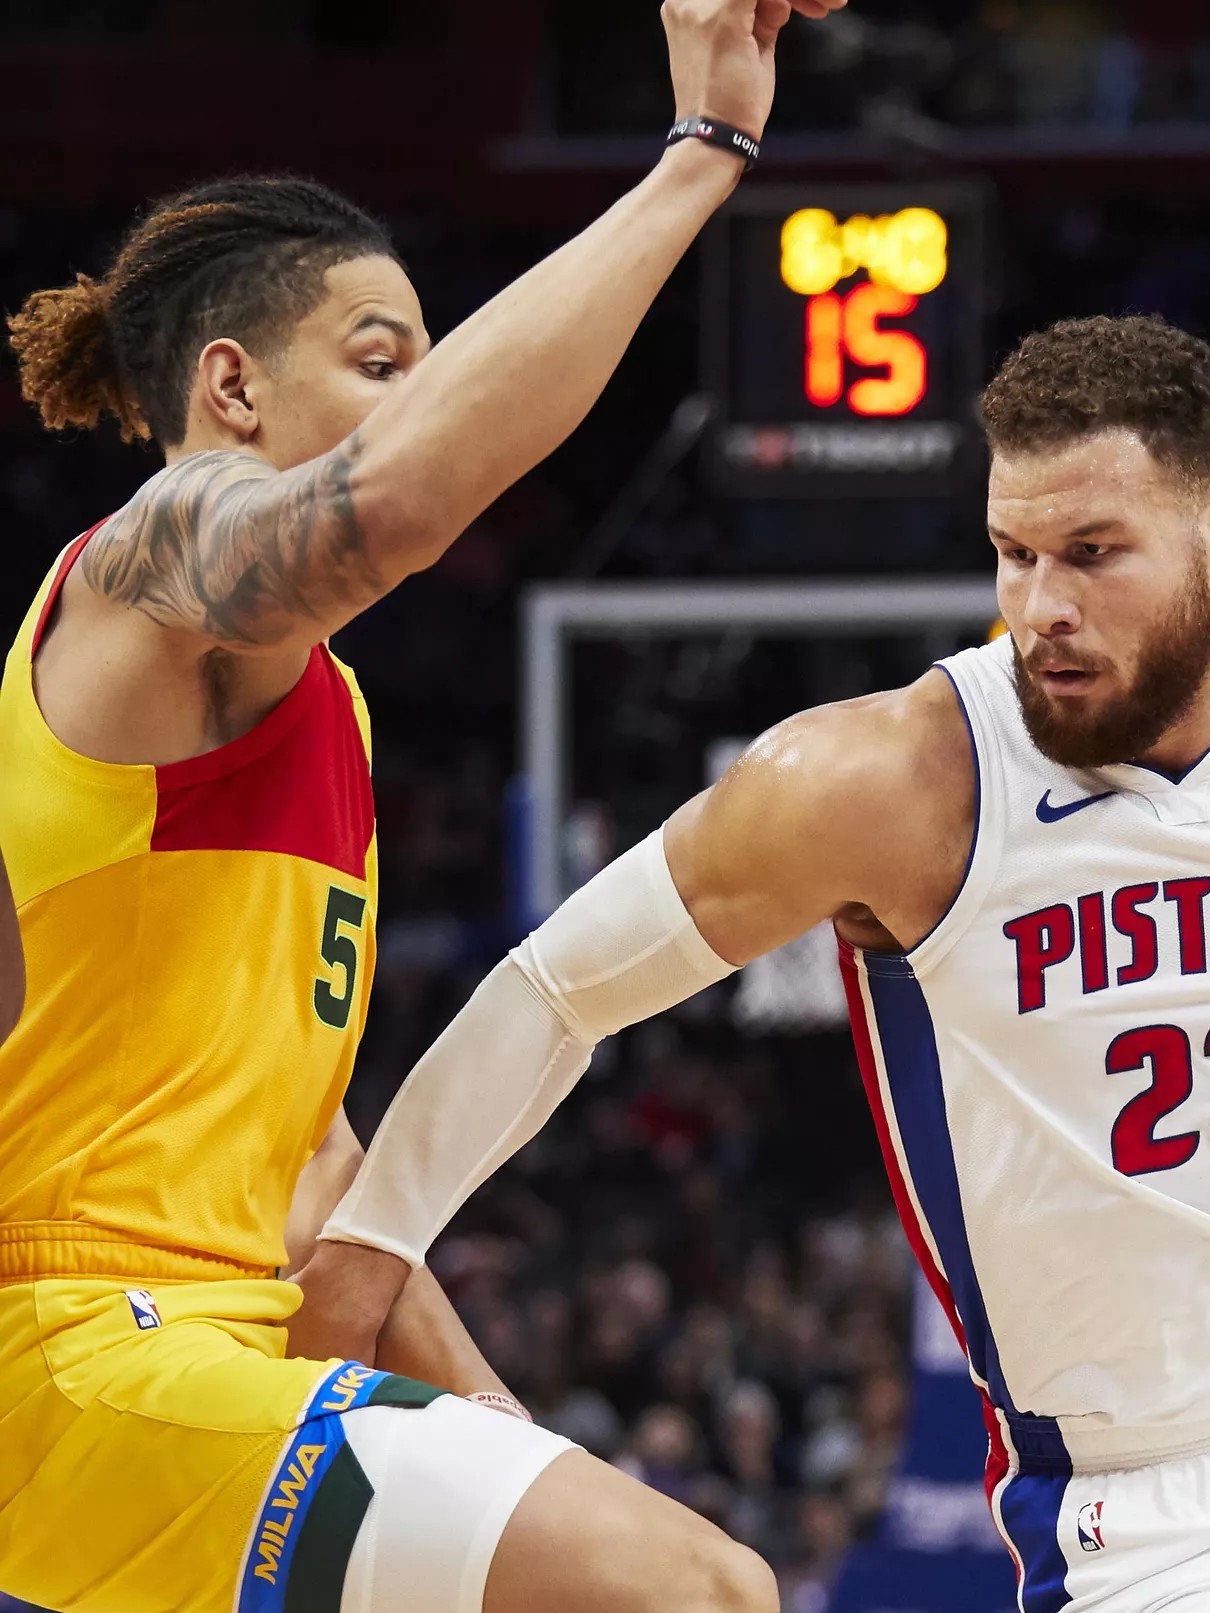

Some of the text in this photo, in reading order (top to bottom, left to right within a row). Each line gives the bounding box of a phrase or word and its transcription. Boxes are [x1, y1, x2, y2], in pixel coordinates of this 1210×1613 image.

[805, 281, 927, 417] 15
[312, 883, 368, 1032] 5
[138, 1315, 155, 1328] NBA
